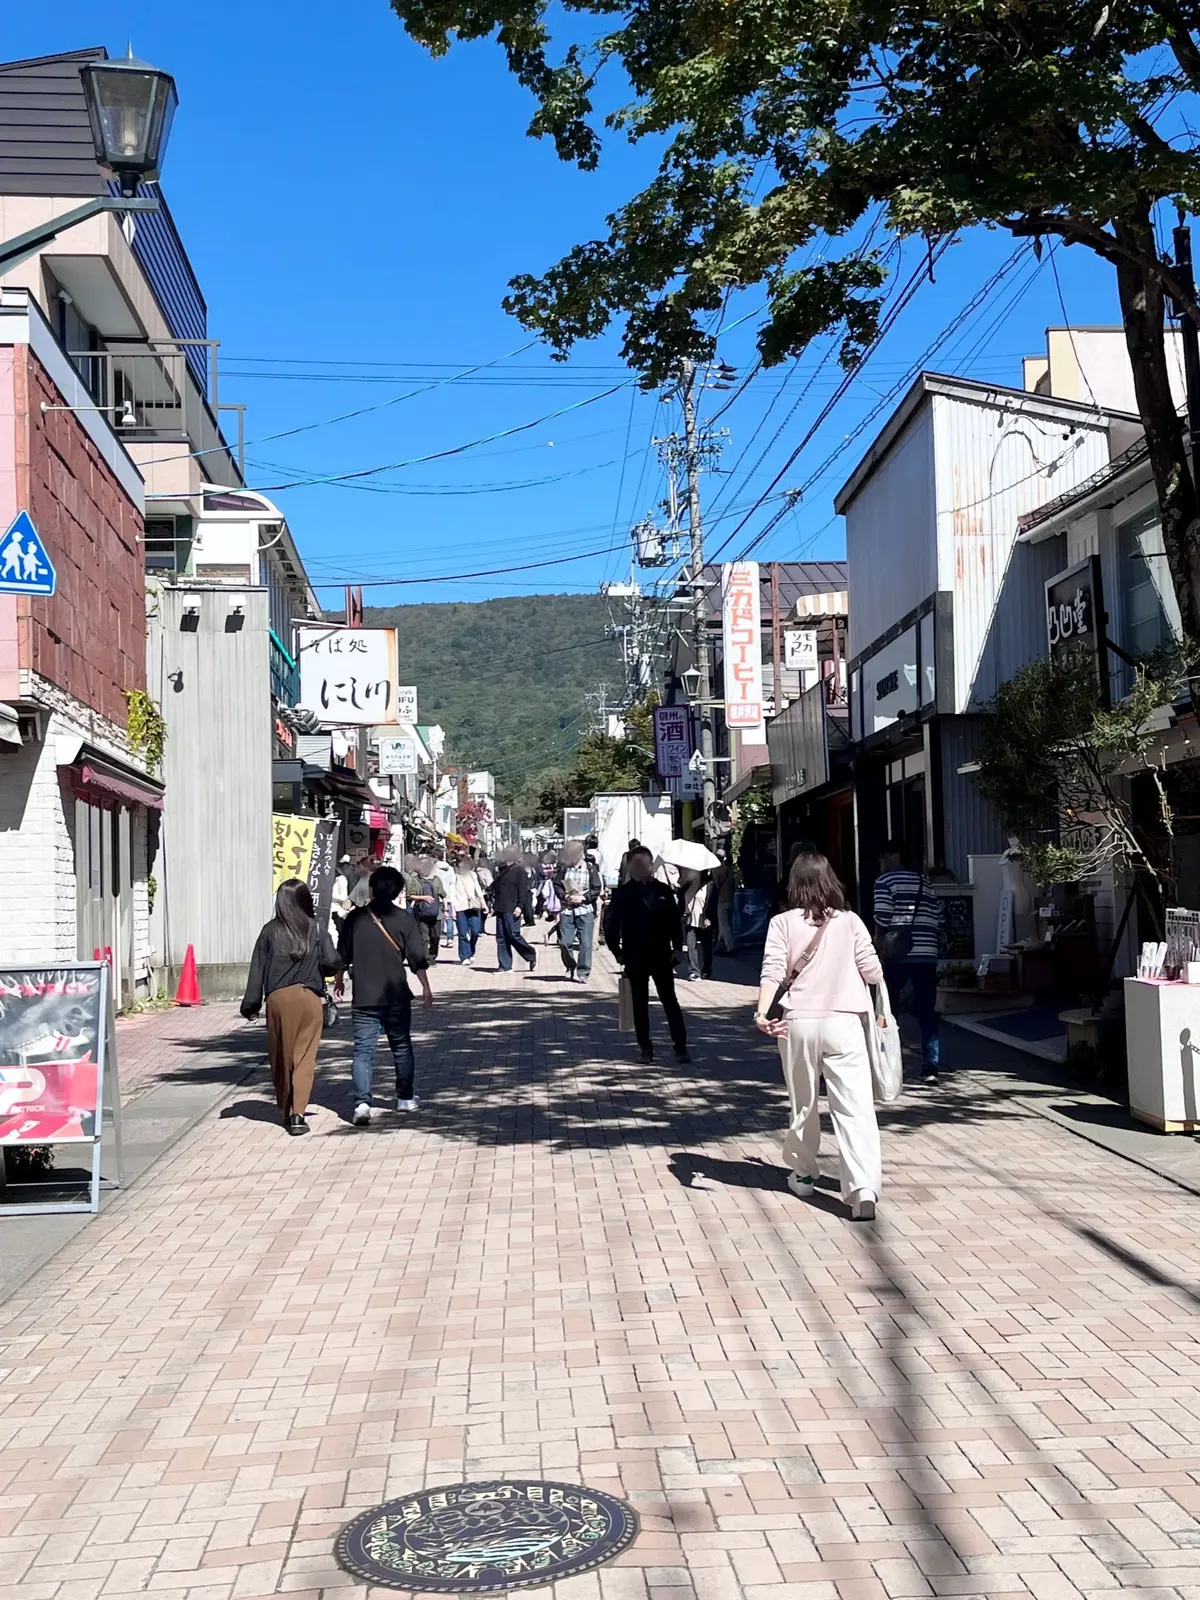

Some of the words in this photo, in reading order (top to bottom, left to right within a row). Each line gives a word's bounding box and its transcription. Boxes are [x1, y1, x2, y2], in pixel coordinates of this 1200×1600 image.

[310, 638, 369, 654] そば処
[729, 571, 754, 700] ミカドコーヒー
[791, 632, 802, 657] ソフト
[802, 632, 813, 652] モカ
[320, 676, 391, 711] にし川
[659, 710, 685, 721] 信州の
[659, 720, 685, 742] 酒
[668, 744, 687, 753] ワイン
[323, 833, 335, 876] はちみつ入り
[309, 833, 324, 916] いきなり団
[999, 896, 1009, 946] OPE
